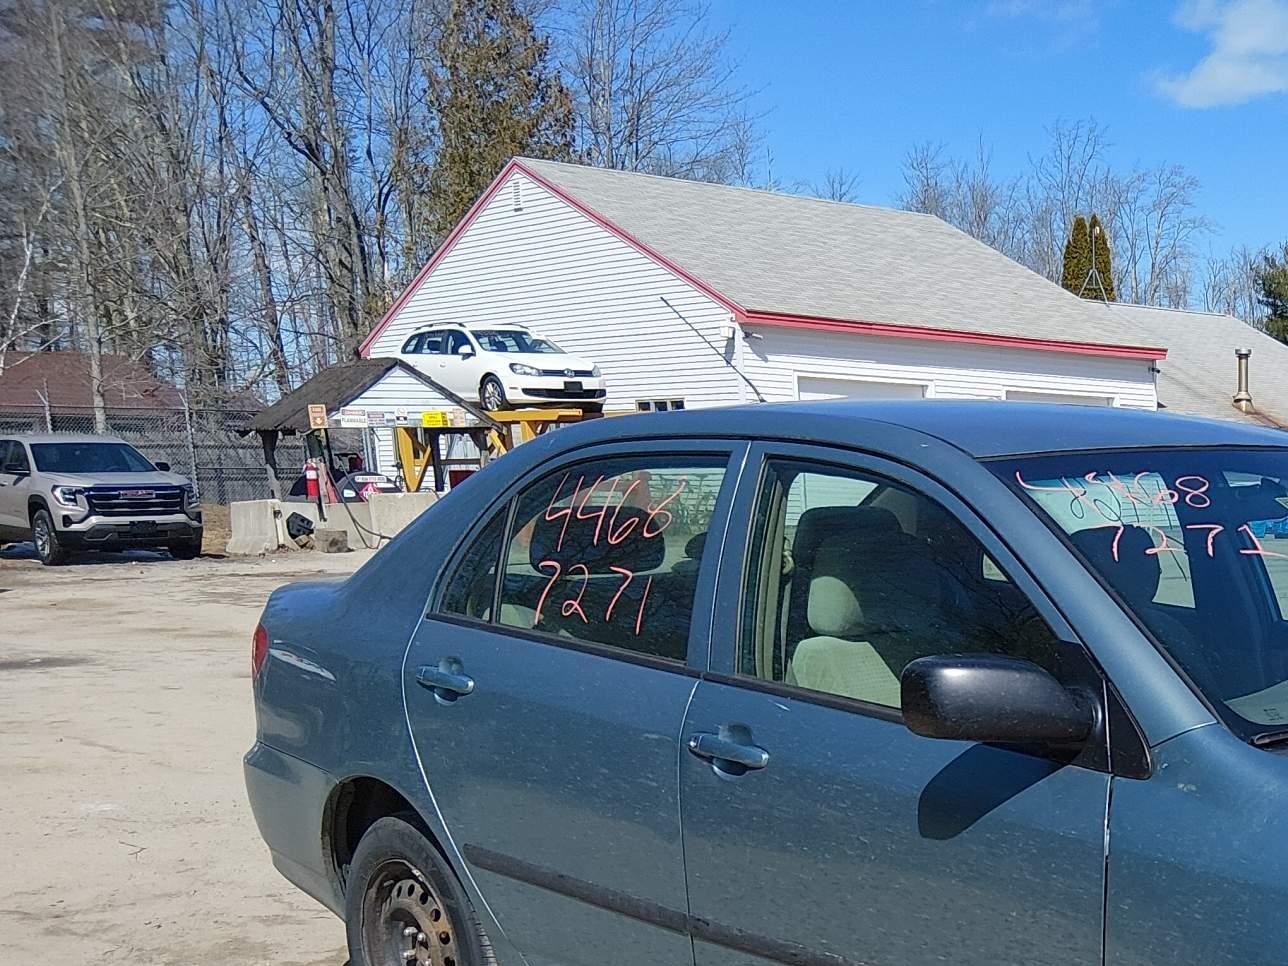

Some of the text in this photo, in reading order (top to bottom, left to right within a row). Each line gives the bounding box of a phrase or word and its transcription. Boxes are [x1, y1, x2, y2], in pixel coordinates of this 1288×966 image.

[545, 472, 689, 552] 4468
[1097, 523, 1288, 562] 7271
[534, 561, 652, 635] 7271
